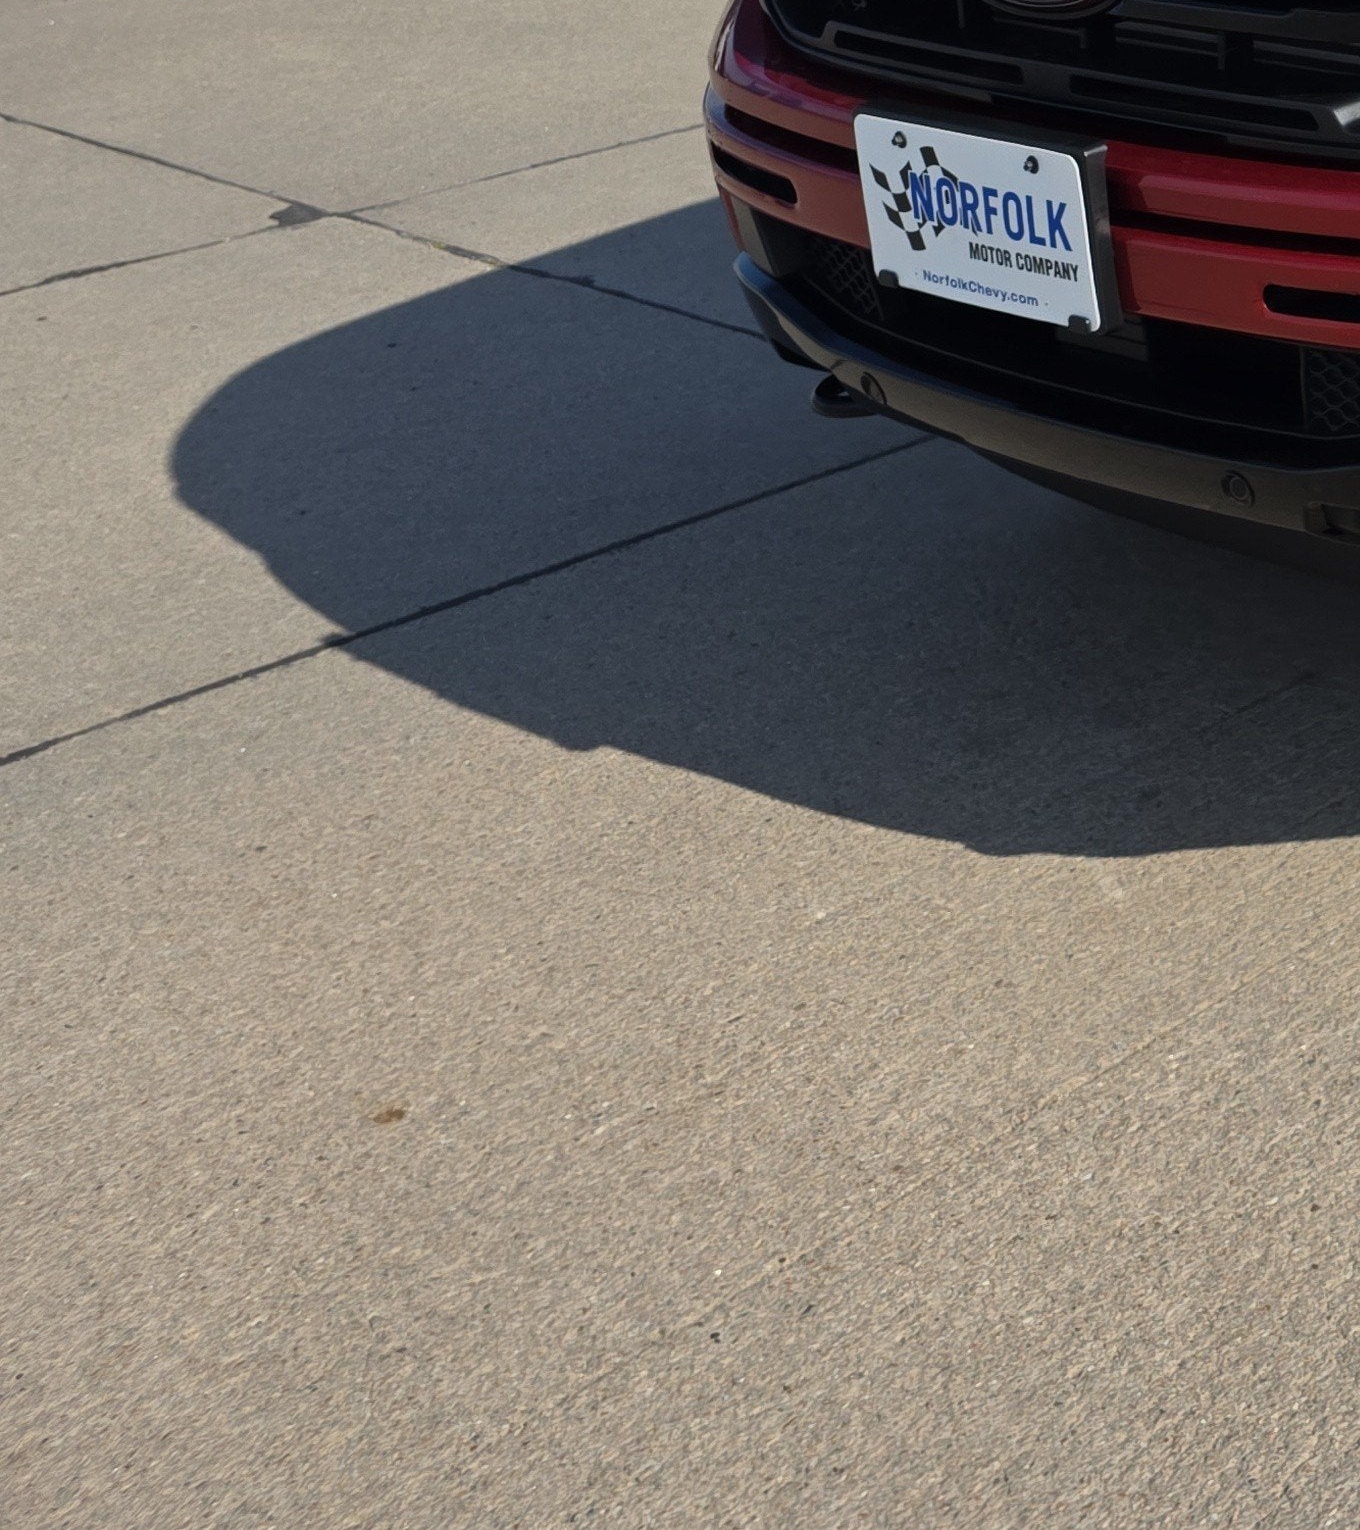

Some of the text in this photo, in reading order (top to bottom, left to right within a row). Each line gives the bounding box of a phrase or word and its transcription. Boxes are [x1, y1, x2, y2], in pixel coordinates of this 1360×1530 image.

[909, 172, 1073, 252] NORFOLK
[968, 242, 1079, 282] MOTOR COMPANY
[923, 270, 1039, 307] NorfolkChevy.com
